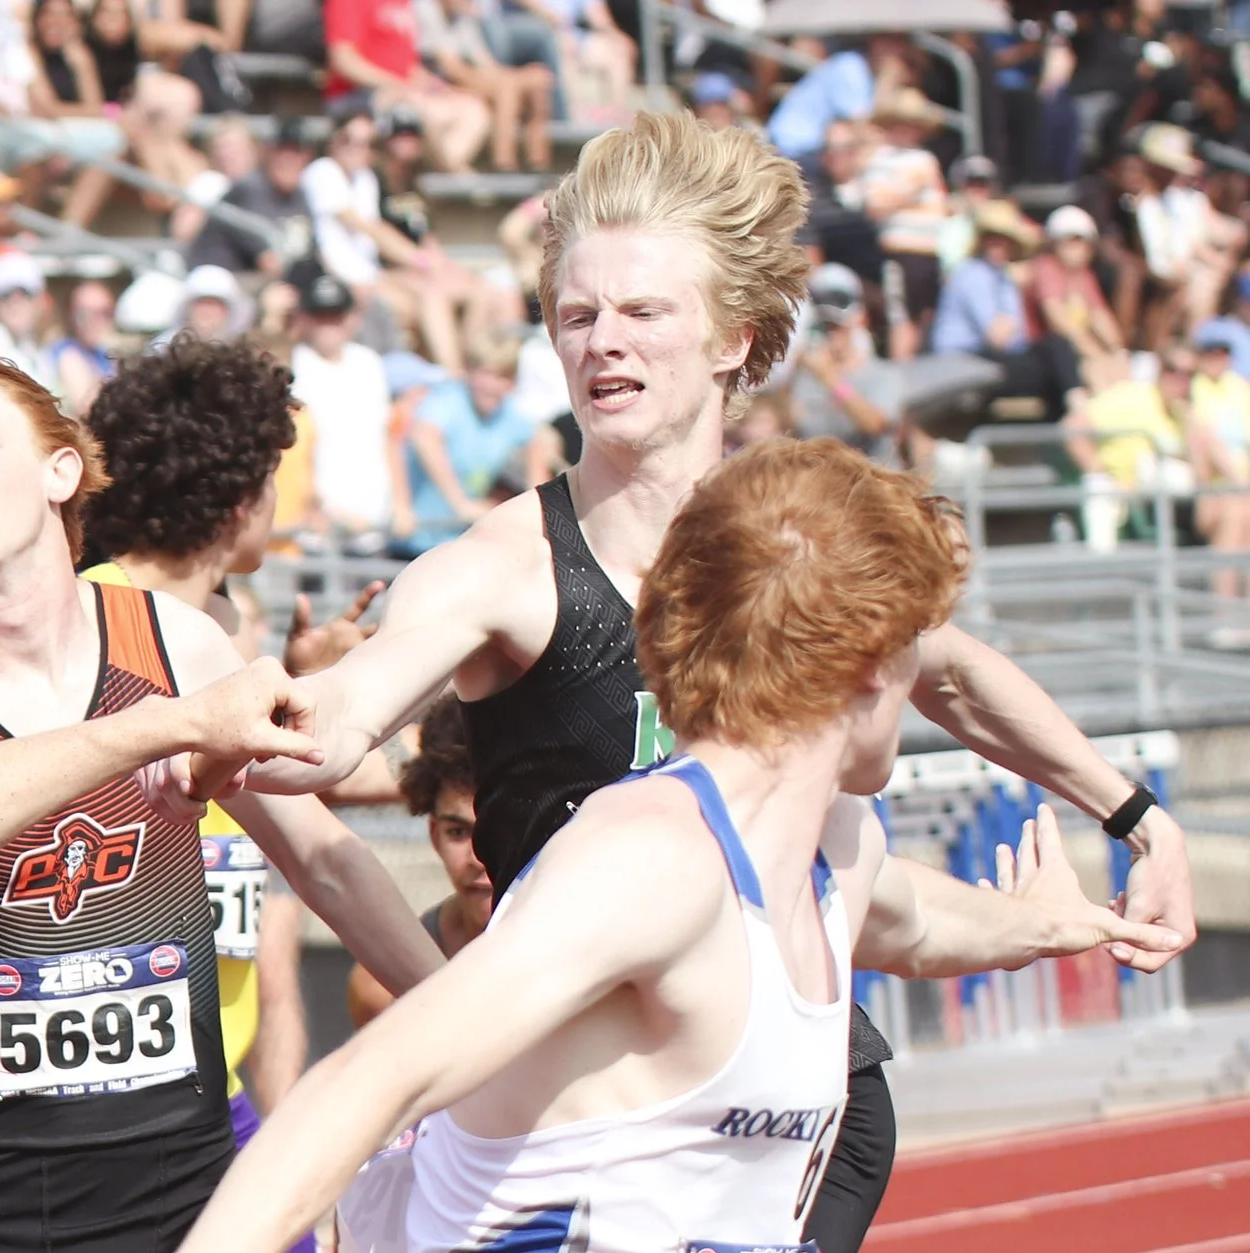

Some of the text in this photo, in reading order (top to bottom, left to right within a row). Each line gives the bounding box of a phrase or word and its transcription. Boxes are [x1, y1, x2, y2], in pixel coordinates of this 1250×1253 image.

[206, 882, 263, 934] 51
[38, 958, 134, 993] ZERO
[60, 952, 110, 967] SHOW-ME
[0, 994, 175, 1074] 5693
